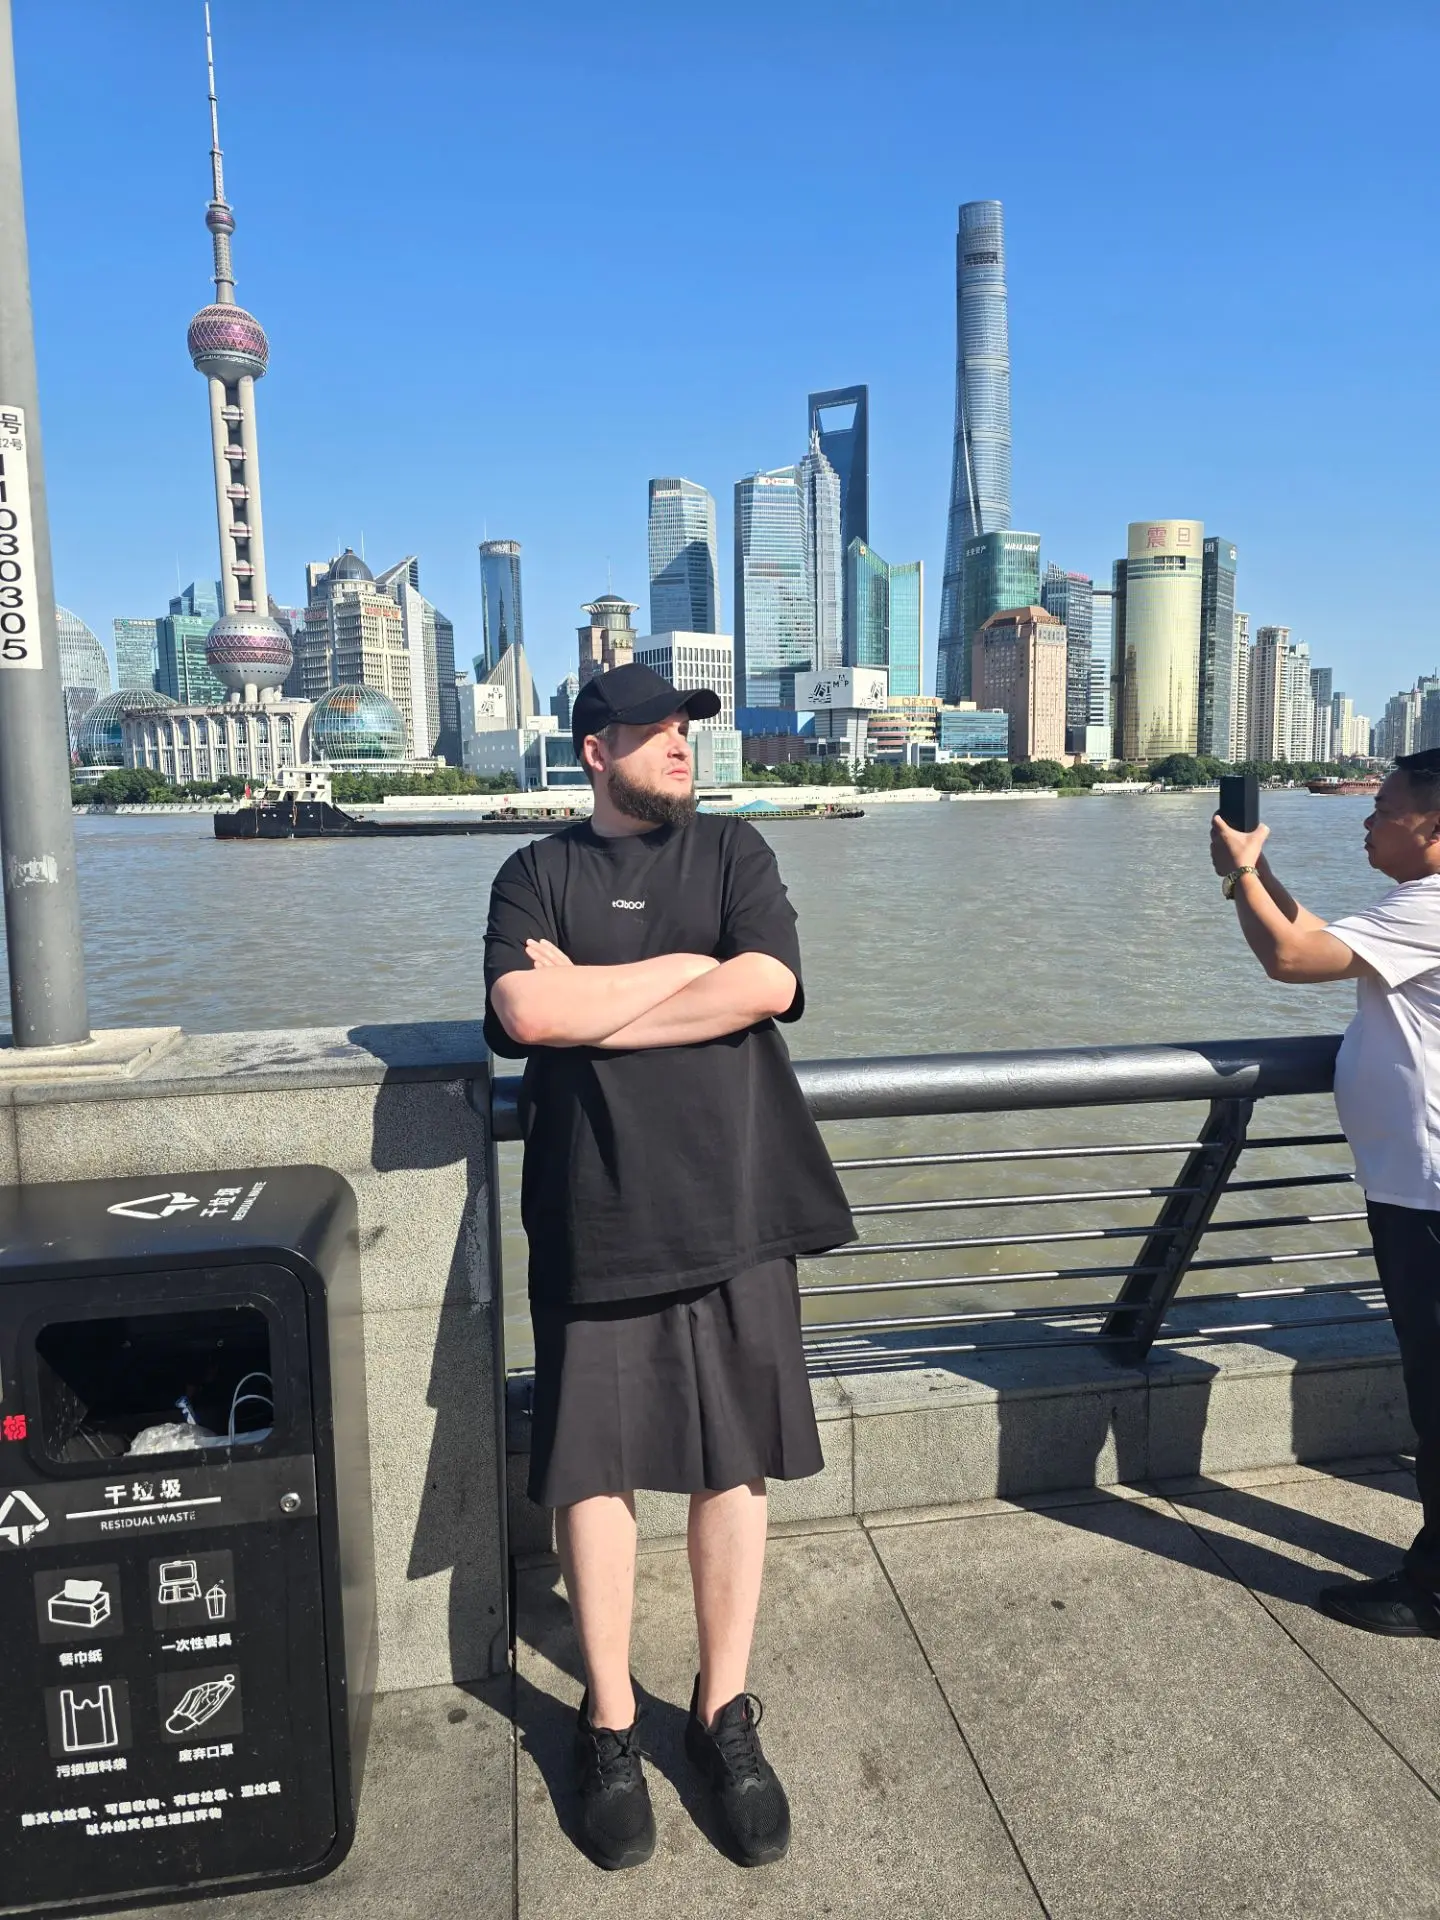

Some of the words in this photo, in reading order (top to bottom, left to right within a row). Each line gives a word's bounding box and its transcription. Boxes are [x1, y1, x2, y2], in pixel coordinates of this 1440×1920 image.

[1146, 527, 1192, 549] 震旦
[104, 1479, 182, 1505] 干垃圾
[100, 1516, 156, 1531] RESIDUAL
[157, 1510, 196, 1524] WASTE
[162, 1633, 232, 1652] 一次性餐具
[59, 1649, 103, 1666] 餐巾纸
[178, 1743, 234, 1763] 废弃口罩
[56, 1757, 127, 1778] 污损塑料袋
